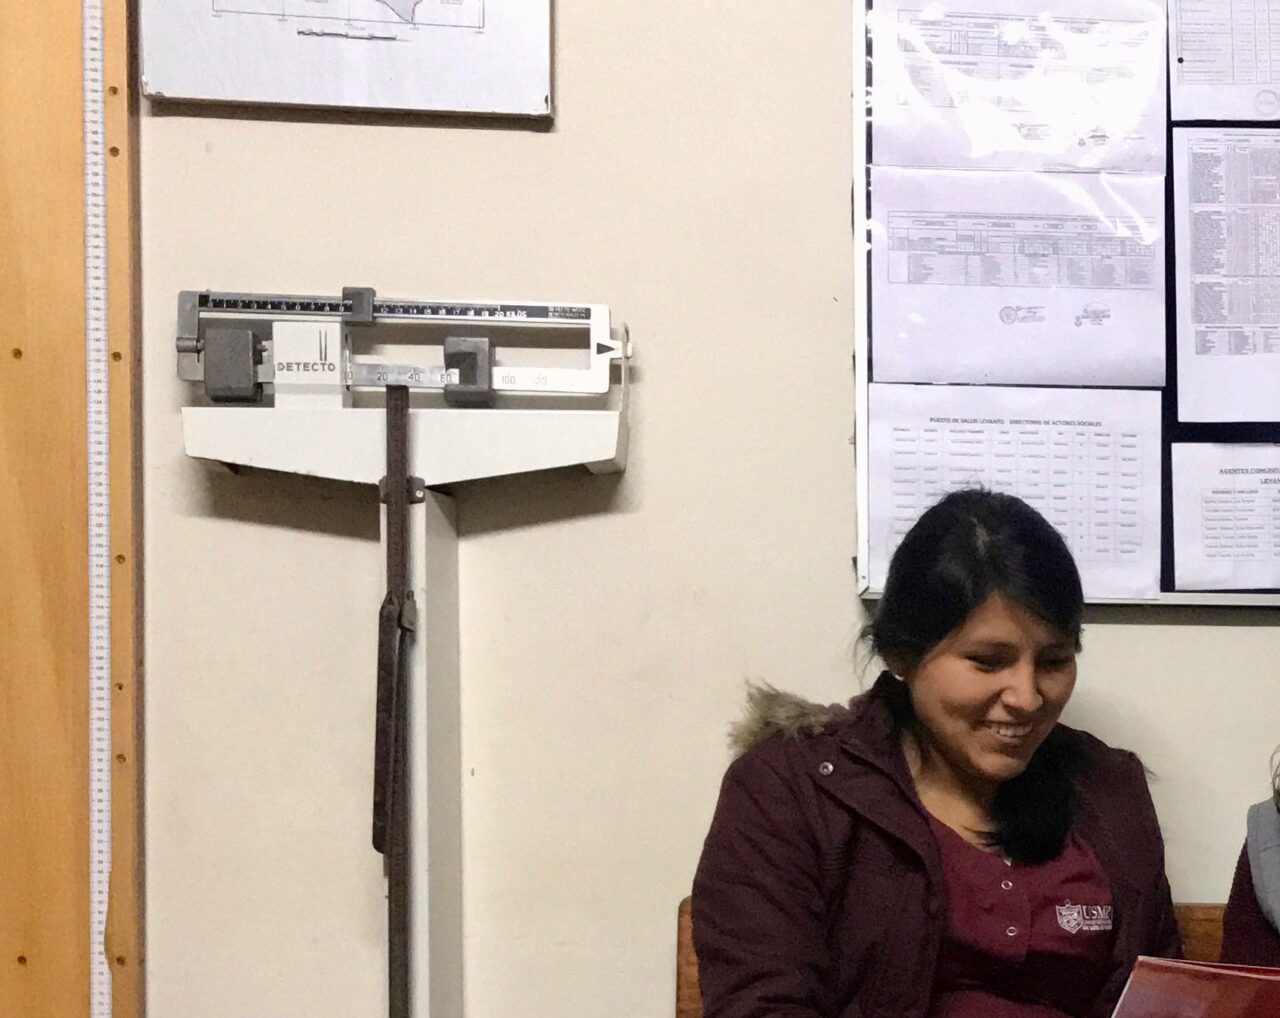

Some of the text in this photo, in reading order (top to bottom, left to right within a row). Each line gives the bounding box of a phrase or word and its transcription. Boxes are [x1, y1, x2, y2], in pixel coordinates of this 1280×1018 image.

[277, 362, 336, 372] DETECTO
[376, 371, 388, 382] 20
[408, 372, 421, 382] 40
[440, 373, 451, 383] 60
[501, 375, 516, 385] 100
